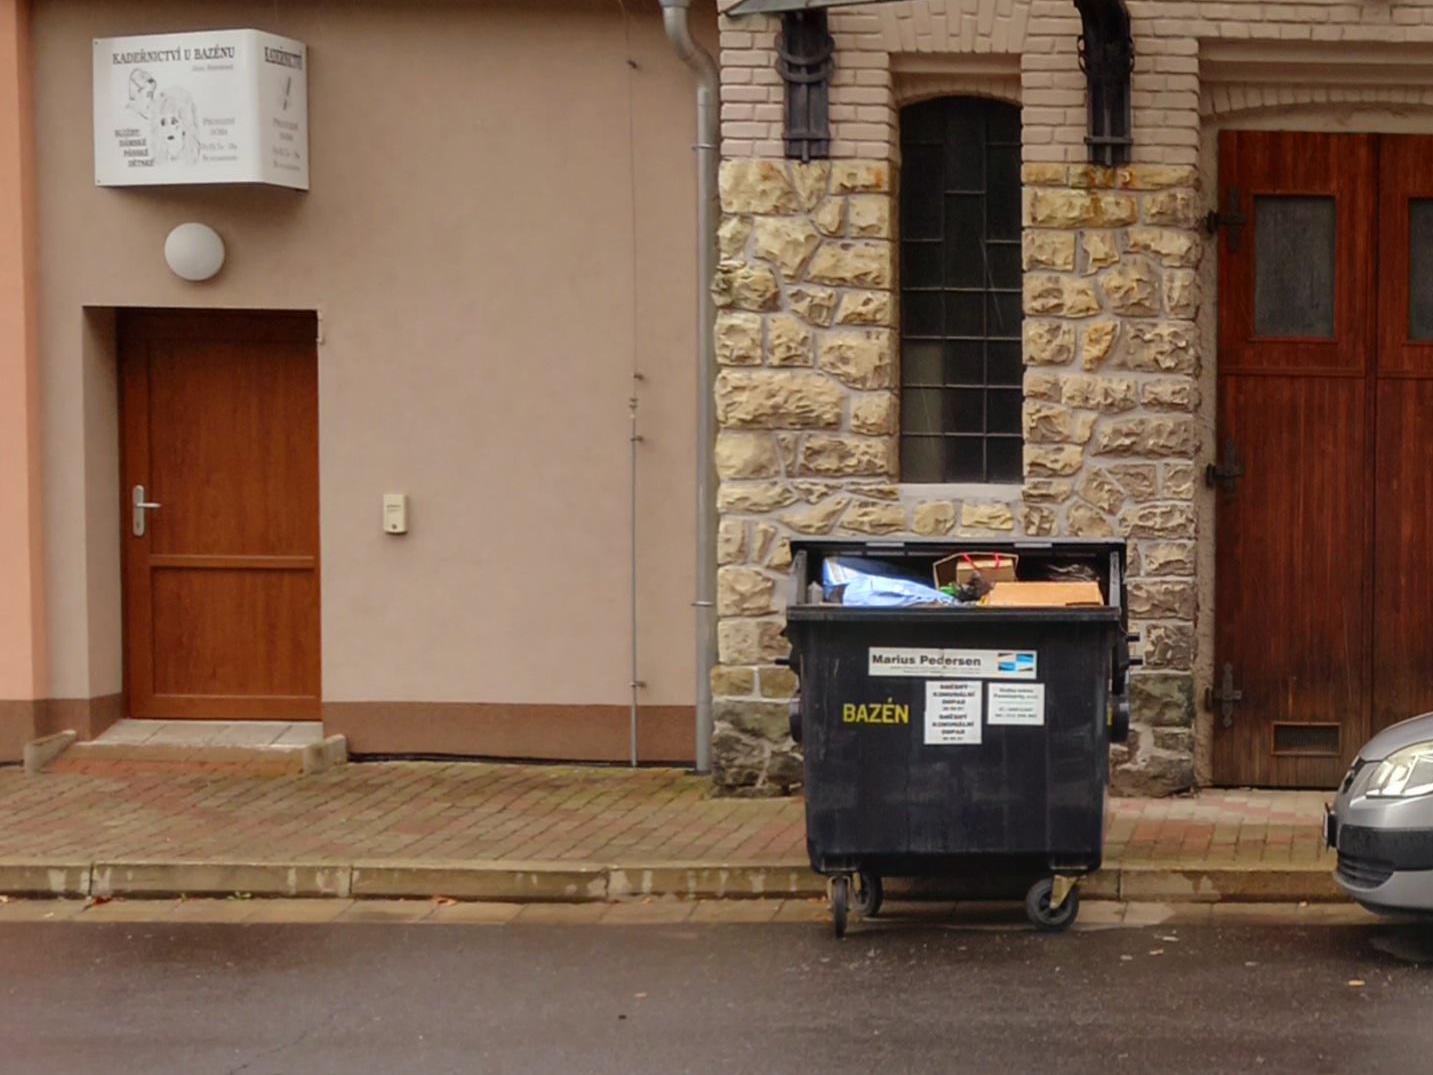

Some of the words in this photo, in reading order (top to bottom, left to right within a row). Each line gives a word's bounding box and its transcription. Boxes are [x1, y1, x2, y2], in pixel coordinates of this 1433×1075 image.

[184, 49, 191, 61] U
[194, 43, 235, 60] BAZÉNU
[872, 654, 916, 665] Marius
[920, 655, 981, 666] Pedersen
[843, 697, 909, 724] BAZÉN
